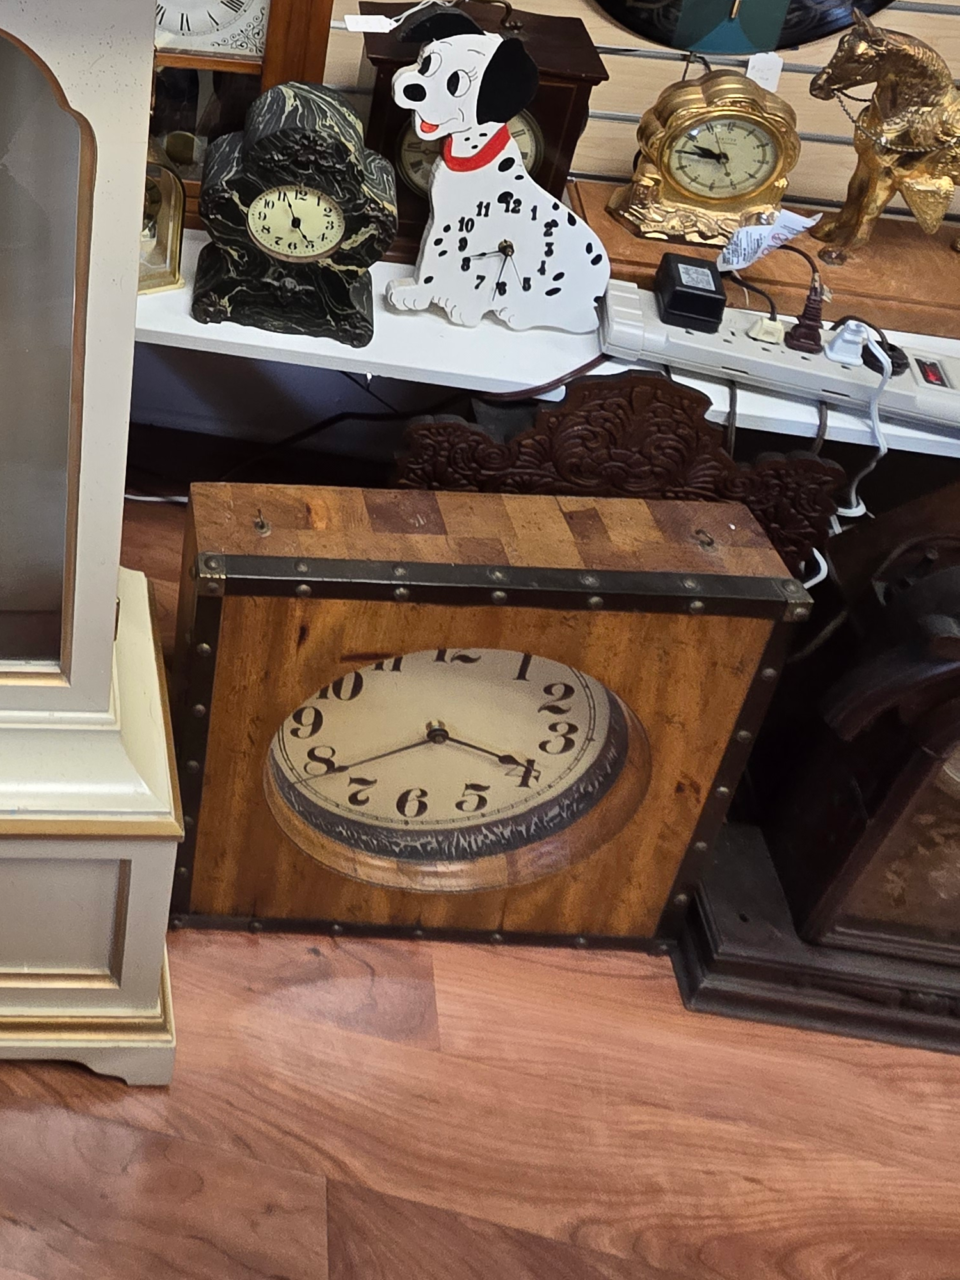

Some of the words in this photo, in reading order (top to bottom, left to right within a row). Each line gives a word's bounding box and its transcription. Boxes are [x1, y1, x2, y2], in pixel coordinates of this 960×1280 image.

[180, 13, 191, 31] VI
[206, 10, 219, 27] V
[278, 190, 287, 202] 11
[295, 190, 308, 201] 12
[317, 196, 321, 207] 1
[264, 199, 275, 209] 10
[476, 201, 491, 217] 11
[503, 198, 522, 214] 12
[258, 211, 267, 221] 9
[323, 207, 333, 218] 2
[531, 205, 537, 221] 1
[261, 225, 271, 234] 8
[325, 220, 335, 231] 3
[458, 217, 475, 233] 10
[543, 221, 553, 237] 2
[275, 236, 283, 245] 7
[317, 232, 328, 242] 4
[458, 236, 468, 252] 9
[287, 242, 298, 250] 6
[544, 242, 554, 257] 3
[461, 256, 472, 271] 8
[537, 260, 547, 275] 4
[474, 275, 485, 290] 7
[497, 281, 507, 296] 6
[523, 277, 531, 291] 5
[513, 652, 532, 681] 1
[538, 682, 575, 715] 2
[290, 706, 324, 739] 9
[539, 721, 579, 754] 3
[304, 745, 337, 775] 8
[505, 759, 541, 788] 4
[348, 776, 378, 806] 7
[455, 783, 491, 812] 5
[396, 787, 429, 817] 6
